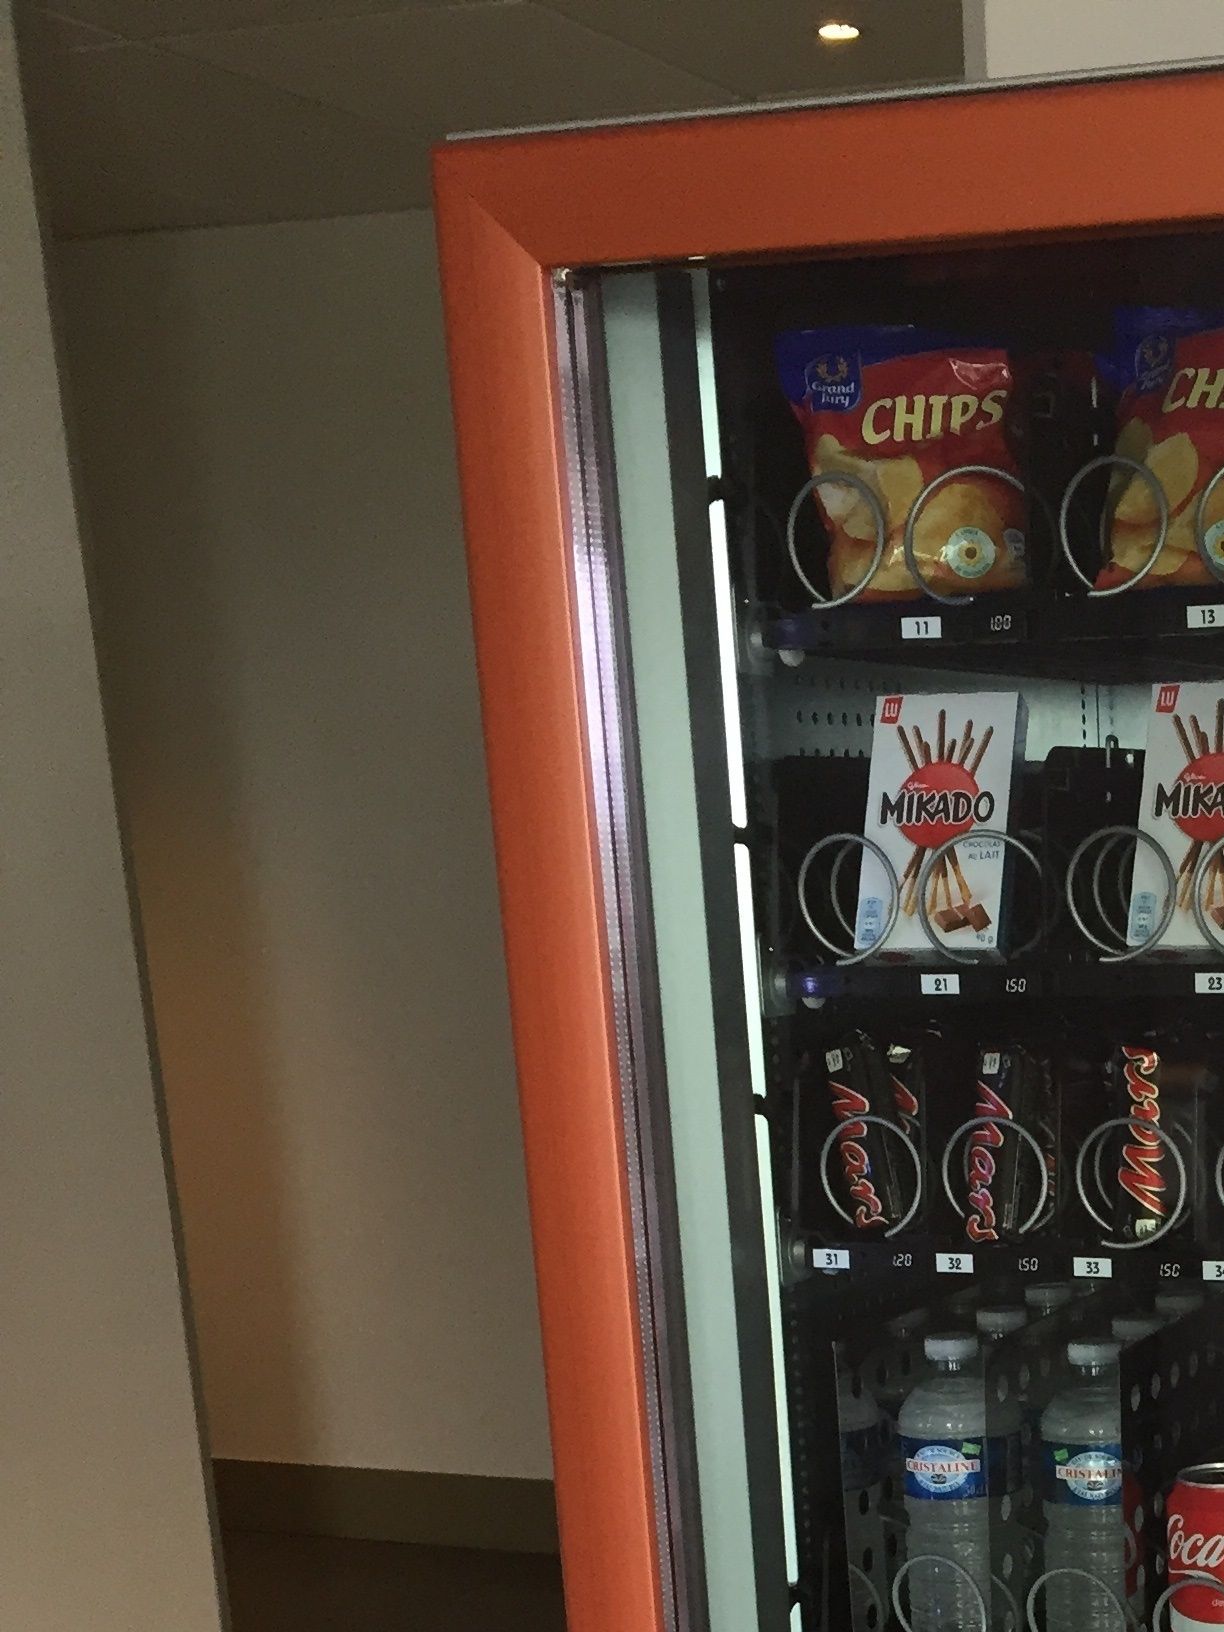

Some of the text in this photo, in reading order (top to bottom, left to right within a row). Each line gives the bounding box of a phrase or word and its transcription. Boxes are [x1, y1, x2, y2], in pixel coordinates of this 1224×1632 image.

[862, 390, 1007, 445] CHIPS
[1201, 609, 1215, 624] 13
[915, 621, 929, 635] 11
[1161, 691, 1173, 706] LU
[880, 791, 995, 826] MIKADO
[934, 978, 947, 991] 21
[1208, 977, 1222, 990] 23
[825, 1252, 839, 1266] 31
[947, 1256, 962, 1271] 32
[1085, 1261, 1100, 1275] 33
